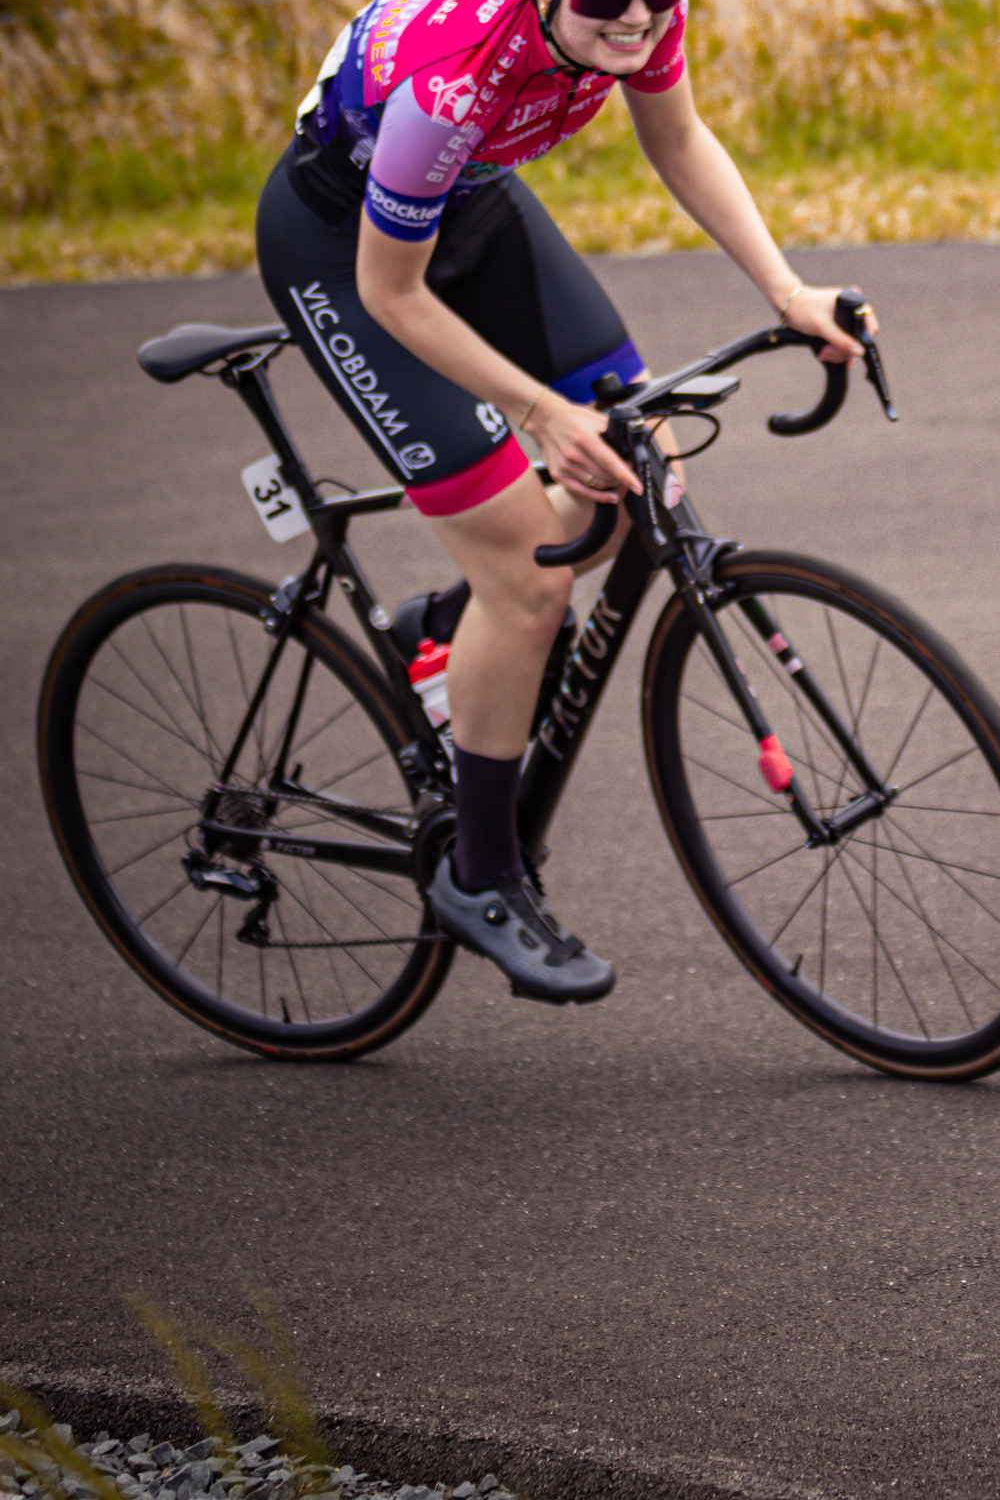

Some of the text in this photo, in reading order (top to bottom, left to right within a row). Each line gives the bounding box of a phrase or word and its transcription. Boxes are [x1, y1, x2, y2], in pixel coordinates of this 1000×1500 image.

[426, 34, 527, 183] BIERSTEKER
[302, 281, 409, 437] VIC OBDAM
[254, 479, 292, 520] 31
